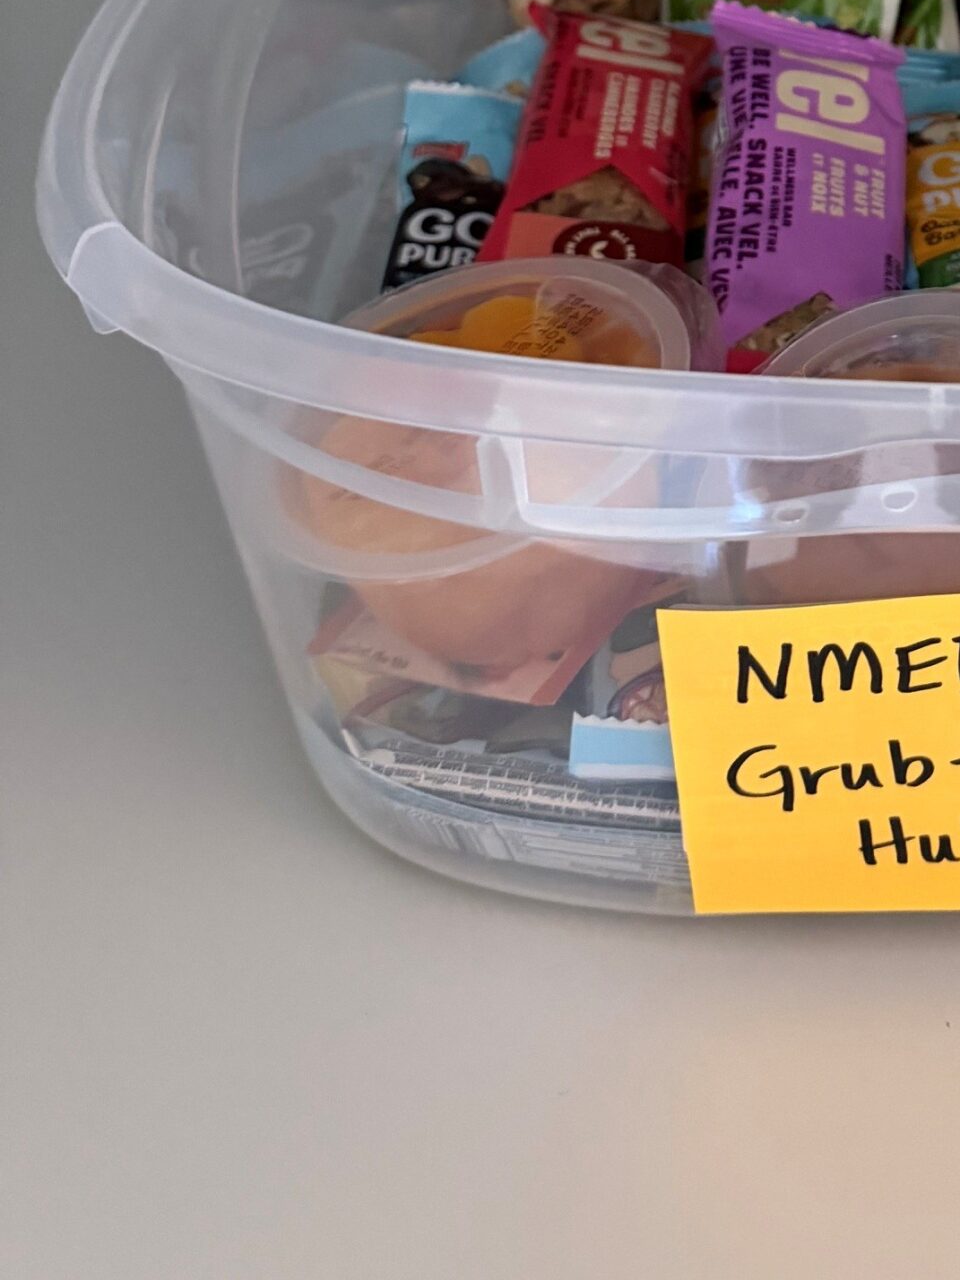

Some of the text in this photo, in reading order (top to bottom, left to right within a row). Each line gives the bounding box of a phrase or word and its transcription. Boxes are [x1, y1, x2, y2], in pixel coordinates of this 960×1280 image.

[729, 45, 748, 84] UNE
[730, 86, 748, 126] VIE
[735, 47, 771, 271] BE WELL. SNACK VEL.
[810, 171, 828, 215] NOIX
[828, 156, 846, 219] FRUITS
[853, 178, 870, 217] NUT
[869, 167, 886, 220] FRUIT
[396, 241, 477, 269] PUR
[712, 206, 737, 263] AVEC
